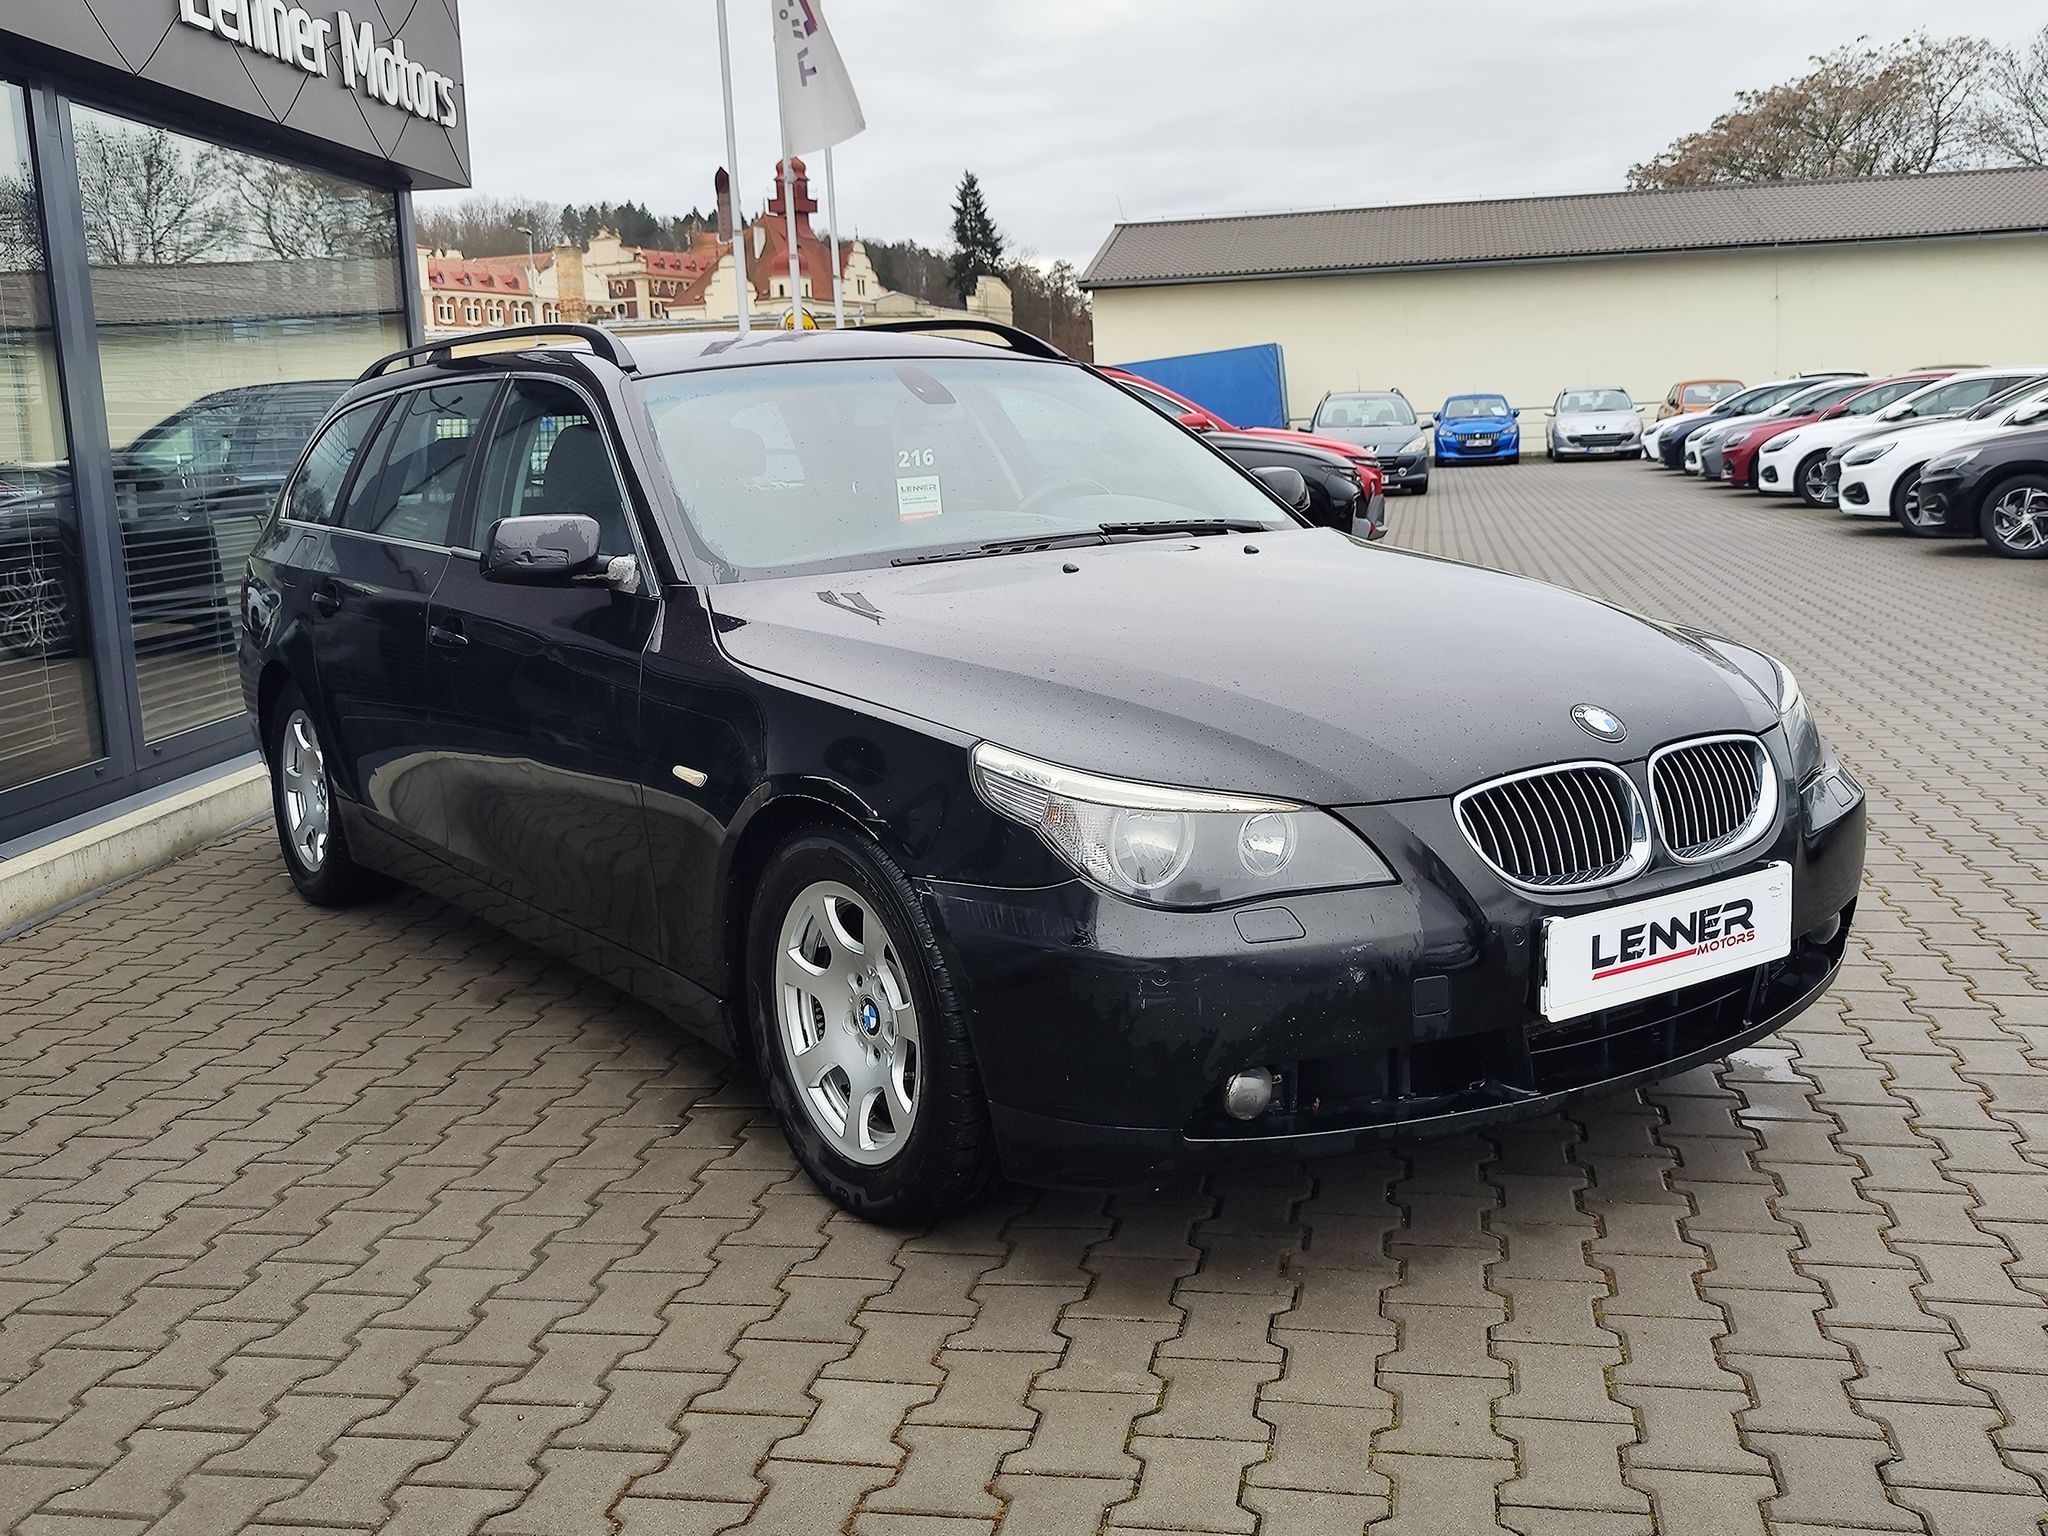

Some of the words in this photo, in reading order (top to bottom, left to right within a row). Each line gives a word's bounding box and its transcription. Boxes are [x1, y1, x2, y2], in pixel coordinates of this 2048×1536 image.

[337, 9, 458, 128] Motors
[898, 448, 935, 468] 216
[1591, 898, 1755, 970] LENNER
[1696, 930, 1756, 956] MOTORS
